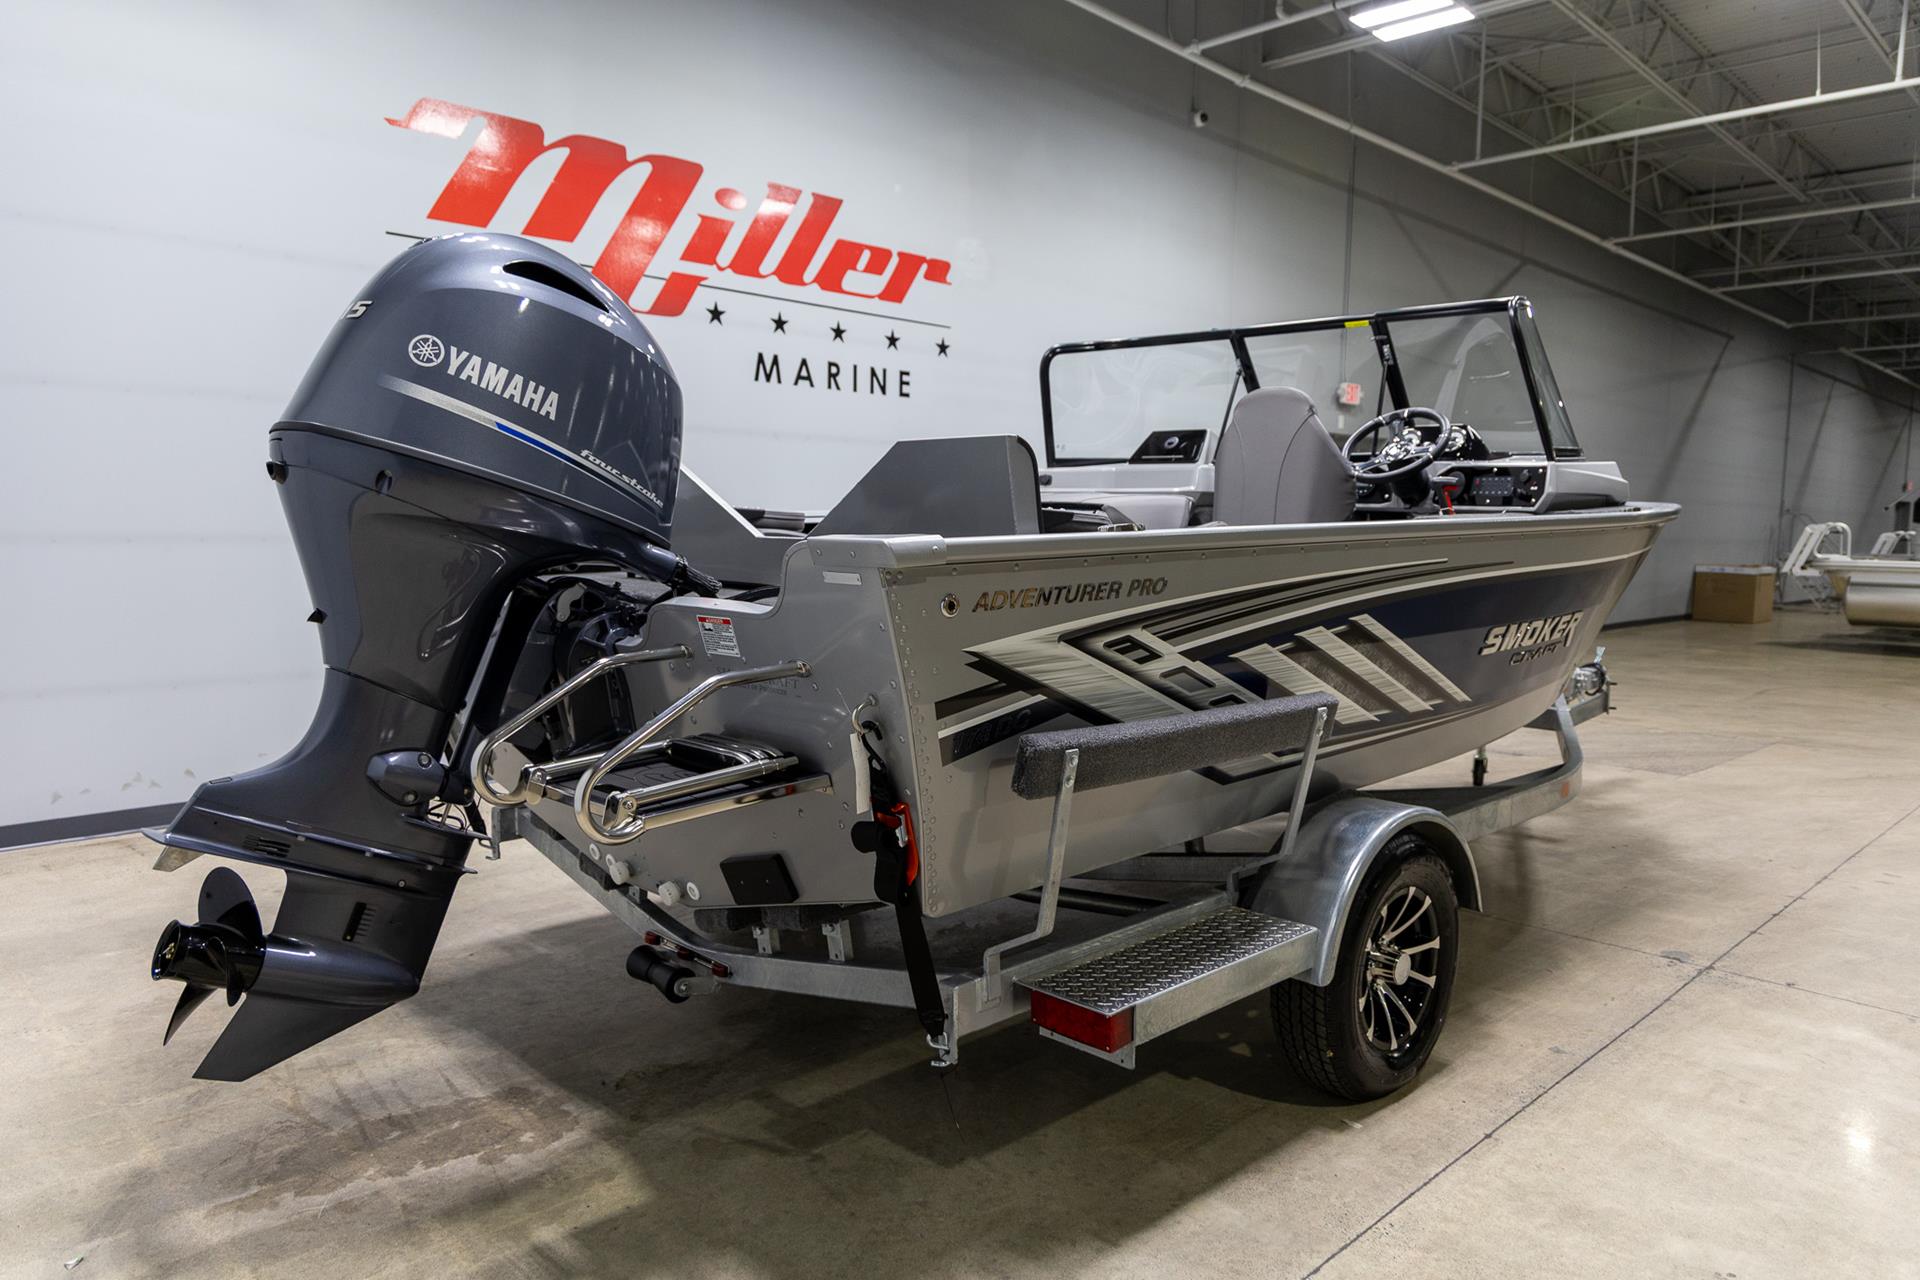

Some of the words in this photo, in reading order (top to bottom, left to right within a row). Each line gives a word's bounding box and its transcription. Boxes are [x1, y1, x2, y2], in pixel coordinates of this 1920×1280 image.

[384, 97, 952, 317] Miller
[447, 345, 559, 421] YAMAHA
[754, 351, 911, 398] MARINE
[972, 579, 1123, 613] ADVENTURER
[1126, 576, 1168, 598] PRO
[1478, 609, 1584, 656] SMOKER
